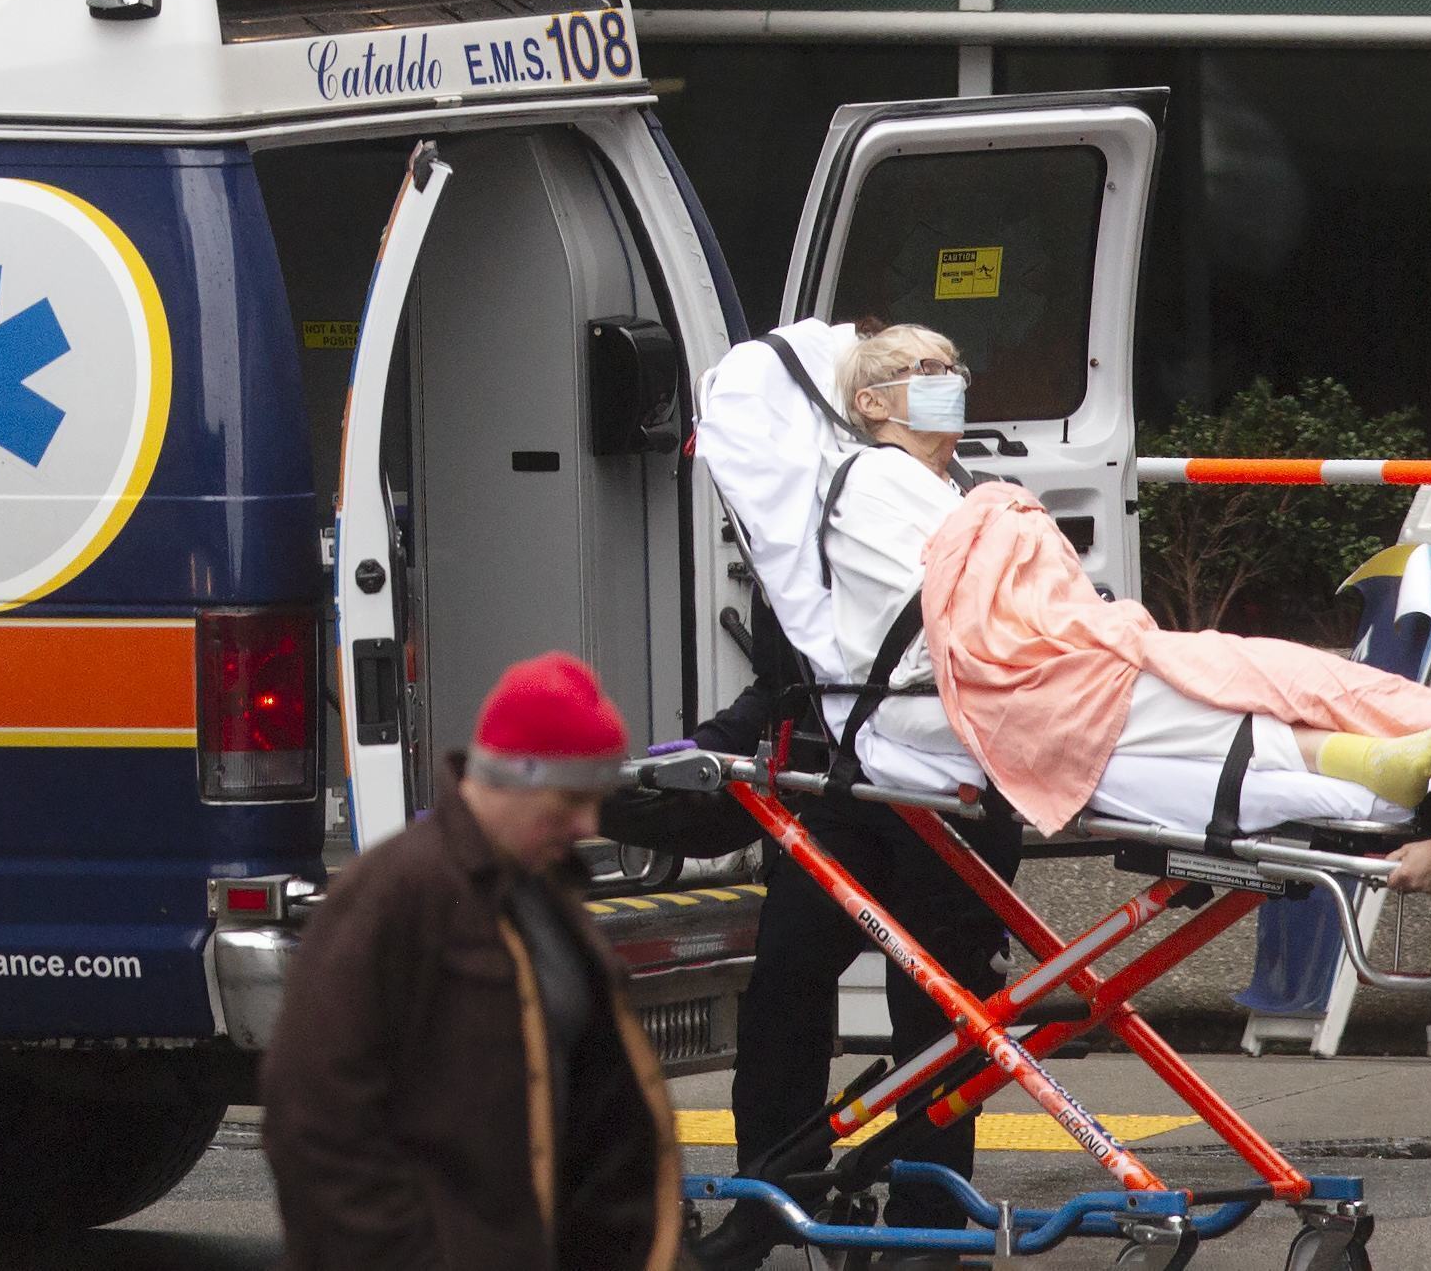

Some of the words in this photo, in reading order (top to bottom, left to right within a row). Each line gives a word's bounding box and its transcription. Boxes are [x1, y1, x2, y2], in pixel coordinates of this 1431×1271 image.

[307, 32, 442, 101] Cataldo
[463, 37, 553, 86] E.M.S.
[546, 7, 633, 84] 108
[943, 252, 976, 262] CAUTION
[305, 323, 325, 334] NOT
[339, 323, 359, 334] SEA
[1170, 867, 1186, 876] FOR
[1057, 1108, 1111, 1158] FERNO
